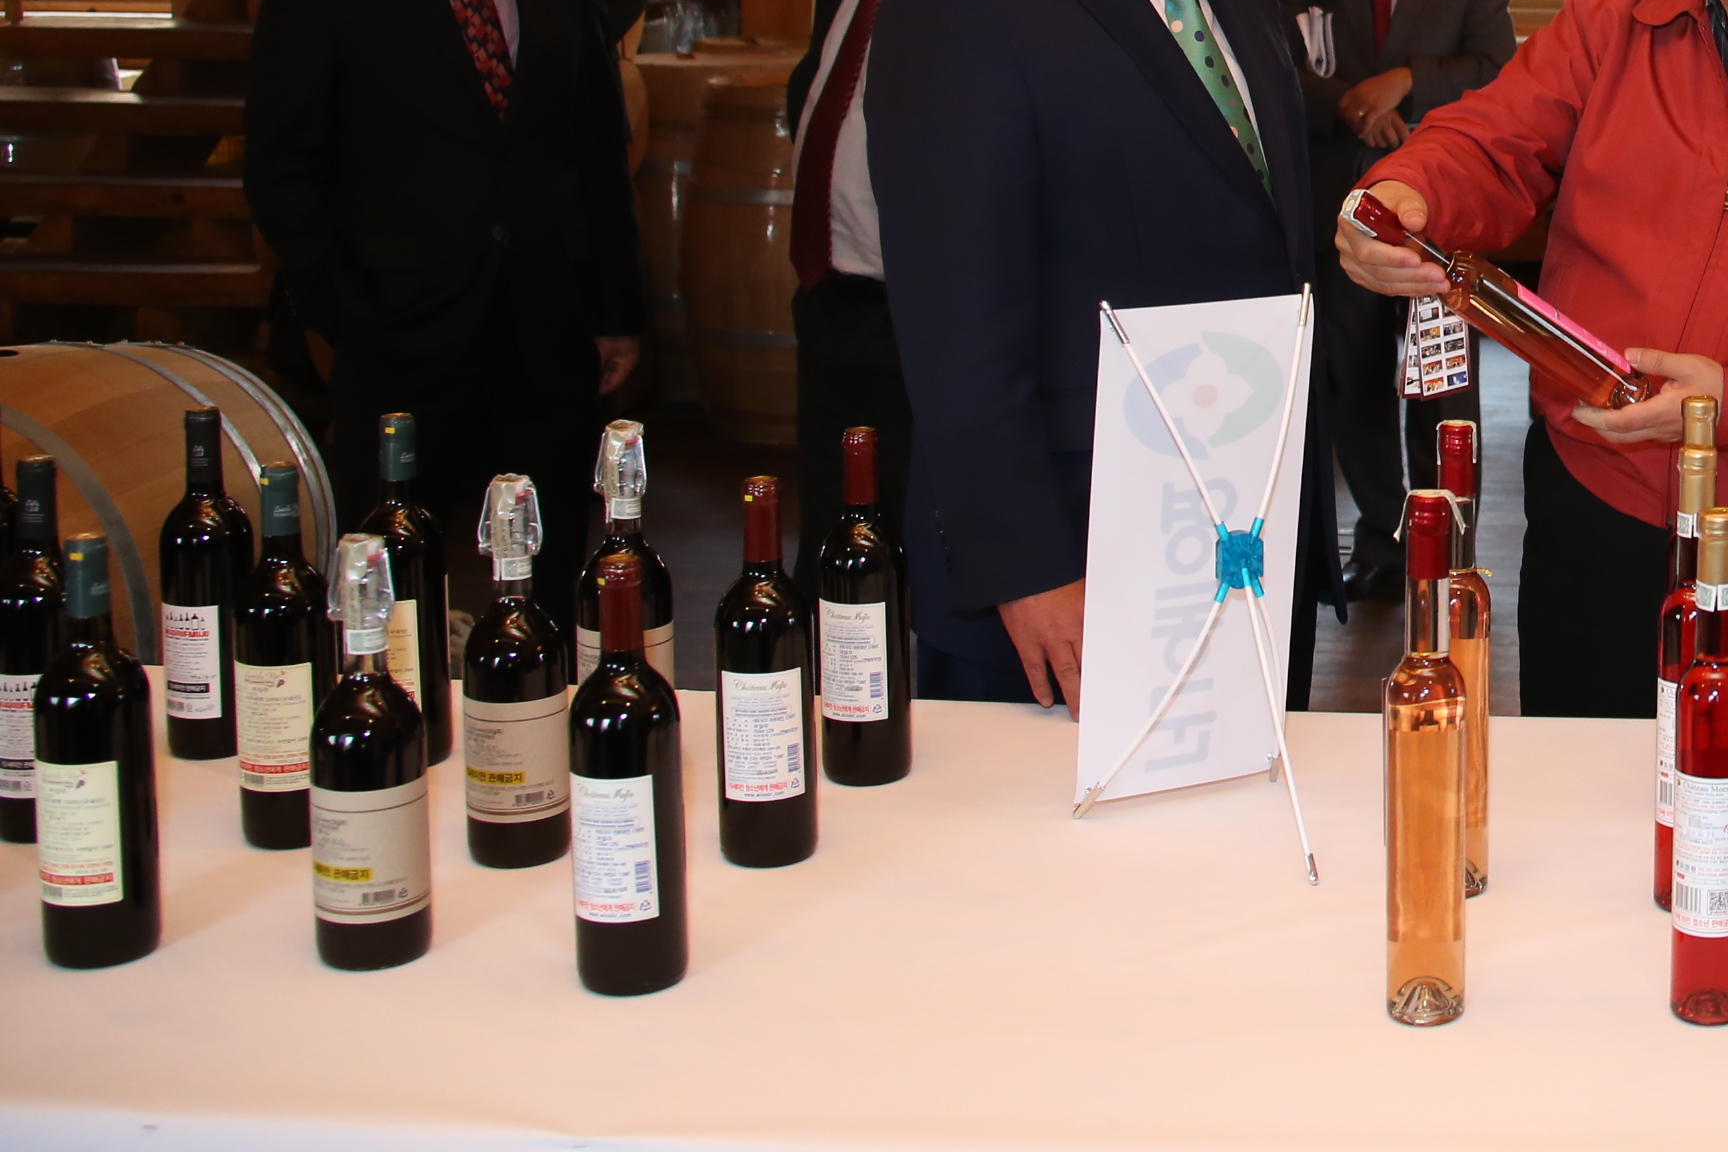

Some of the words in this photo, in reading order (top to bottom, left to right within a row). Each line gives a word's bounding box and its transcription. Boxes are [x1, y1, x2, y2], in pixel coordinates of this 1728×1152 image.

[488, 772, 523, 783] 판매금지
[1682, 780, 1709, 793] Château
[332, 868, 369, 880] 판매금지
[1693, 917, 1710, 928] 청소년
